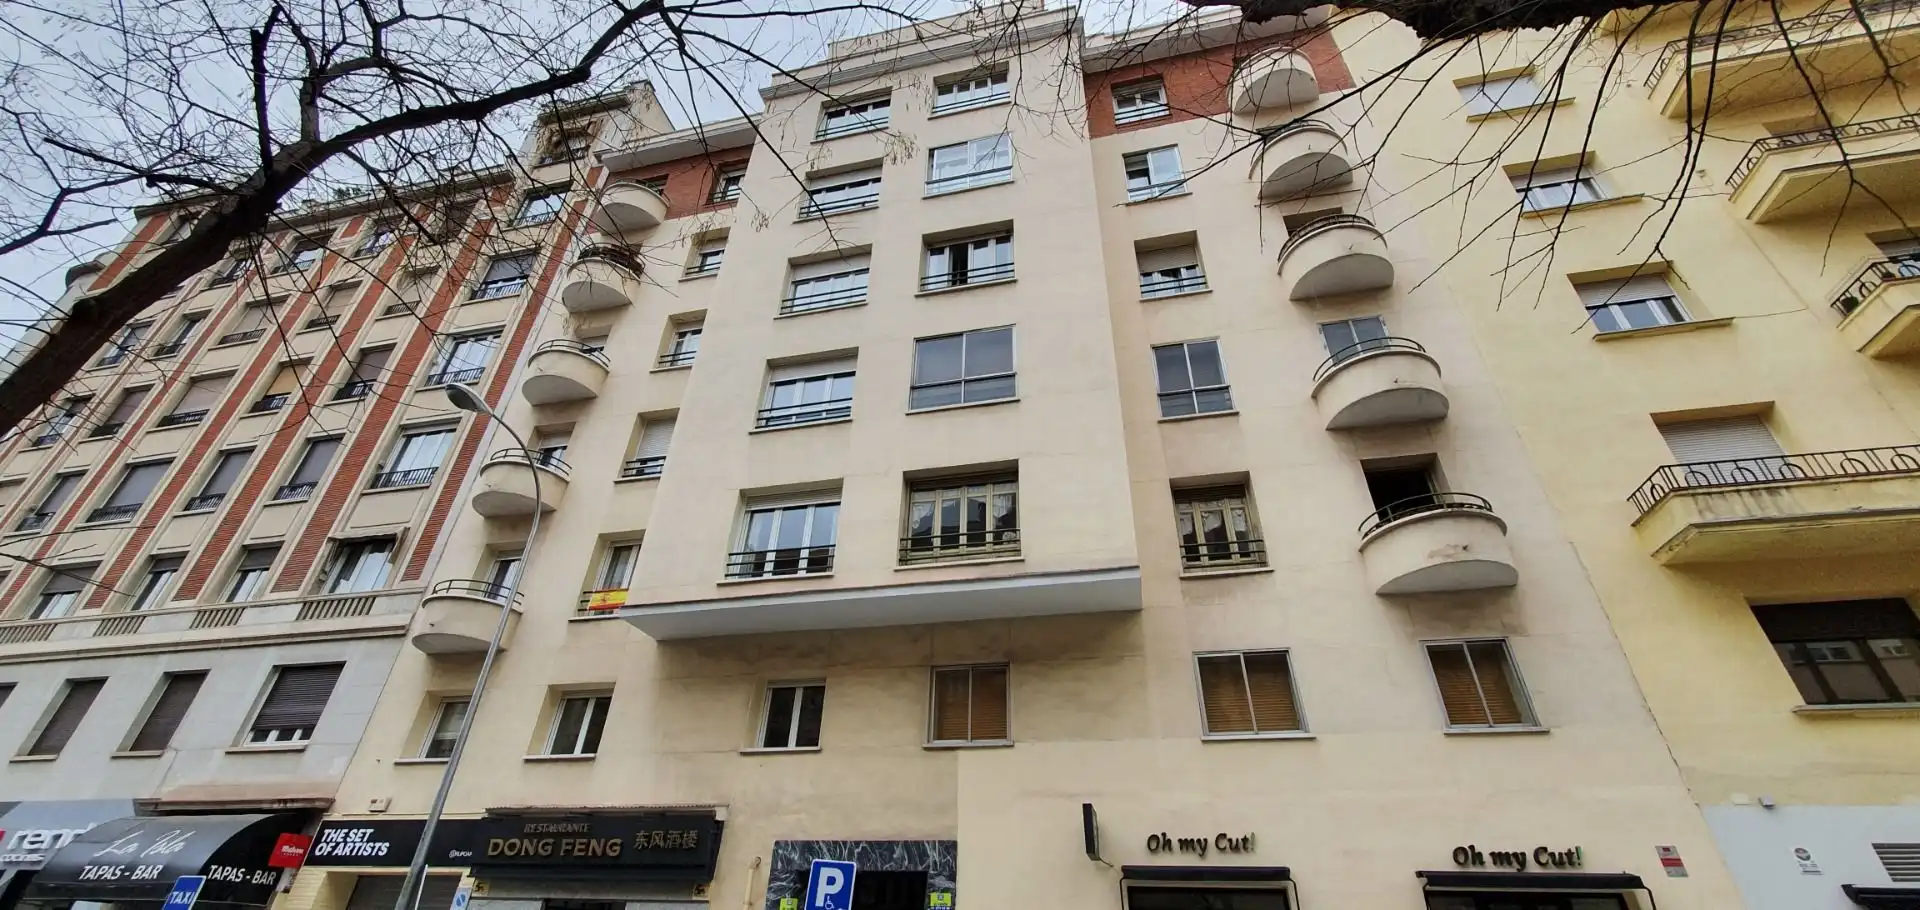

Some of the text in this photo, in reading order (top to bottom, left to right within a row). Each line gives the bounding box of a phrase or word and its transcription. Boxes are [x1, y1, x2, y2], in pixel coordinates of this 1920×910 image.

[320, 828, 375, 843] THE SET
[633, 829, 699, 850] 东风酒楼
[1146, 831, 1257, 859] Oh my Cut!
[314, 842, 390, 857] OF ARTISTS
[487, 838, 554, 857] DONG
[559, 838, 622, 857] FENG
[1452, 844, 1584, 873] Oh my Cut!
[78, 864, 126, 880] TAPAS
[131, 864, 164, 880] BAR
[207, 864, 246, 883] TAPAS
[252, 869, 278, 886] BAR
[814, 866, 845, 908] P
[169, 890, 196, 905] TAXI
